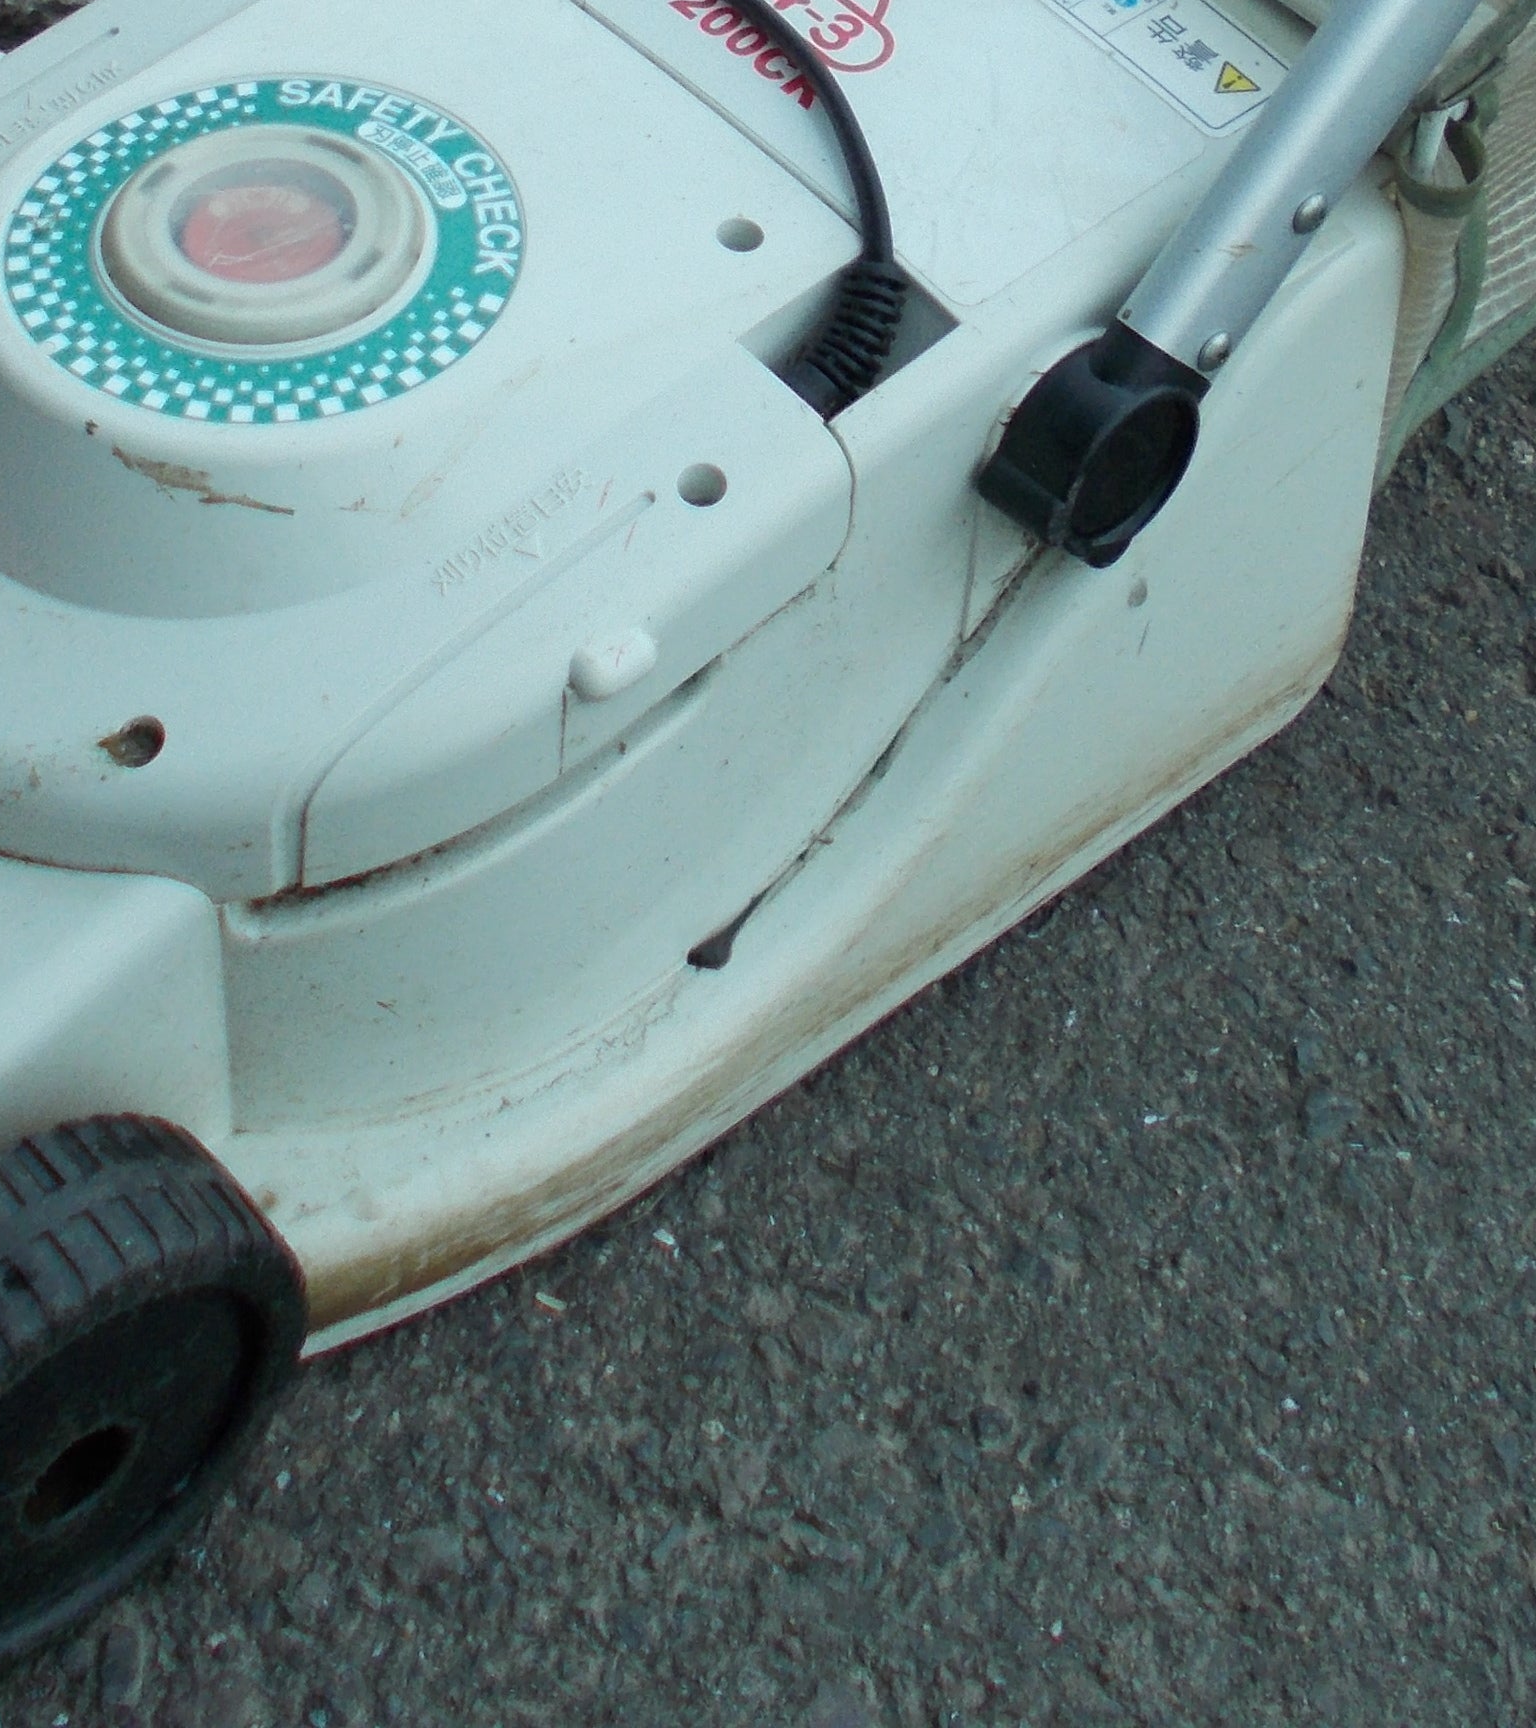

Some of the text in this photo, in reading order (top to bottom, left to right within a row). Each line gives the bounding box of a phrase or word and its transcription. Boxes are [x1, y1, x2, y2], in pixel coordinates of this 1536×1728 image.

[1147, 14, 1219, 73] 警告
[278, 79, 521, 276] SAFETY CHECK
